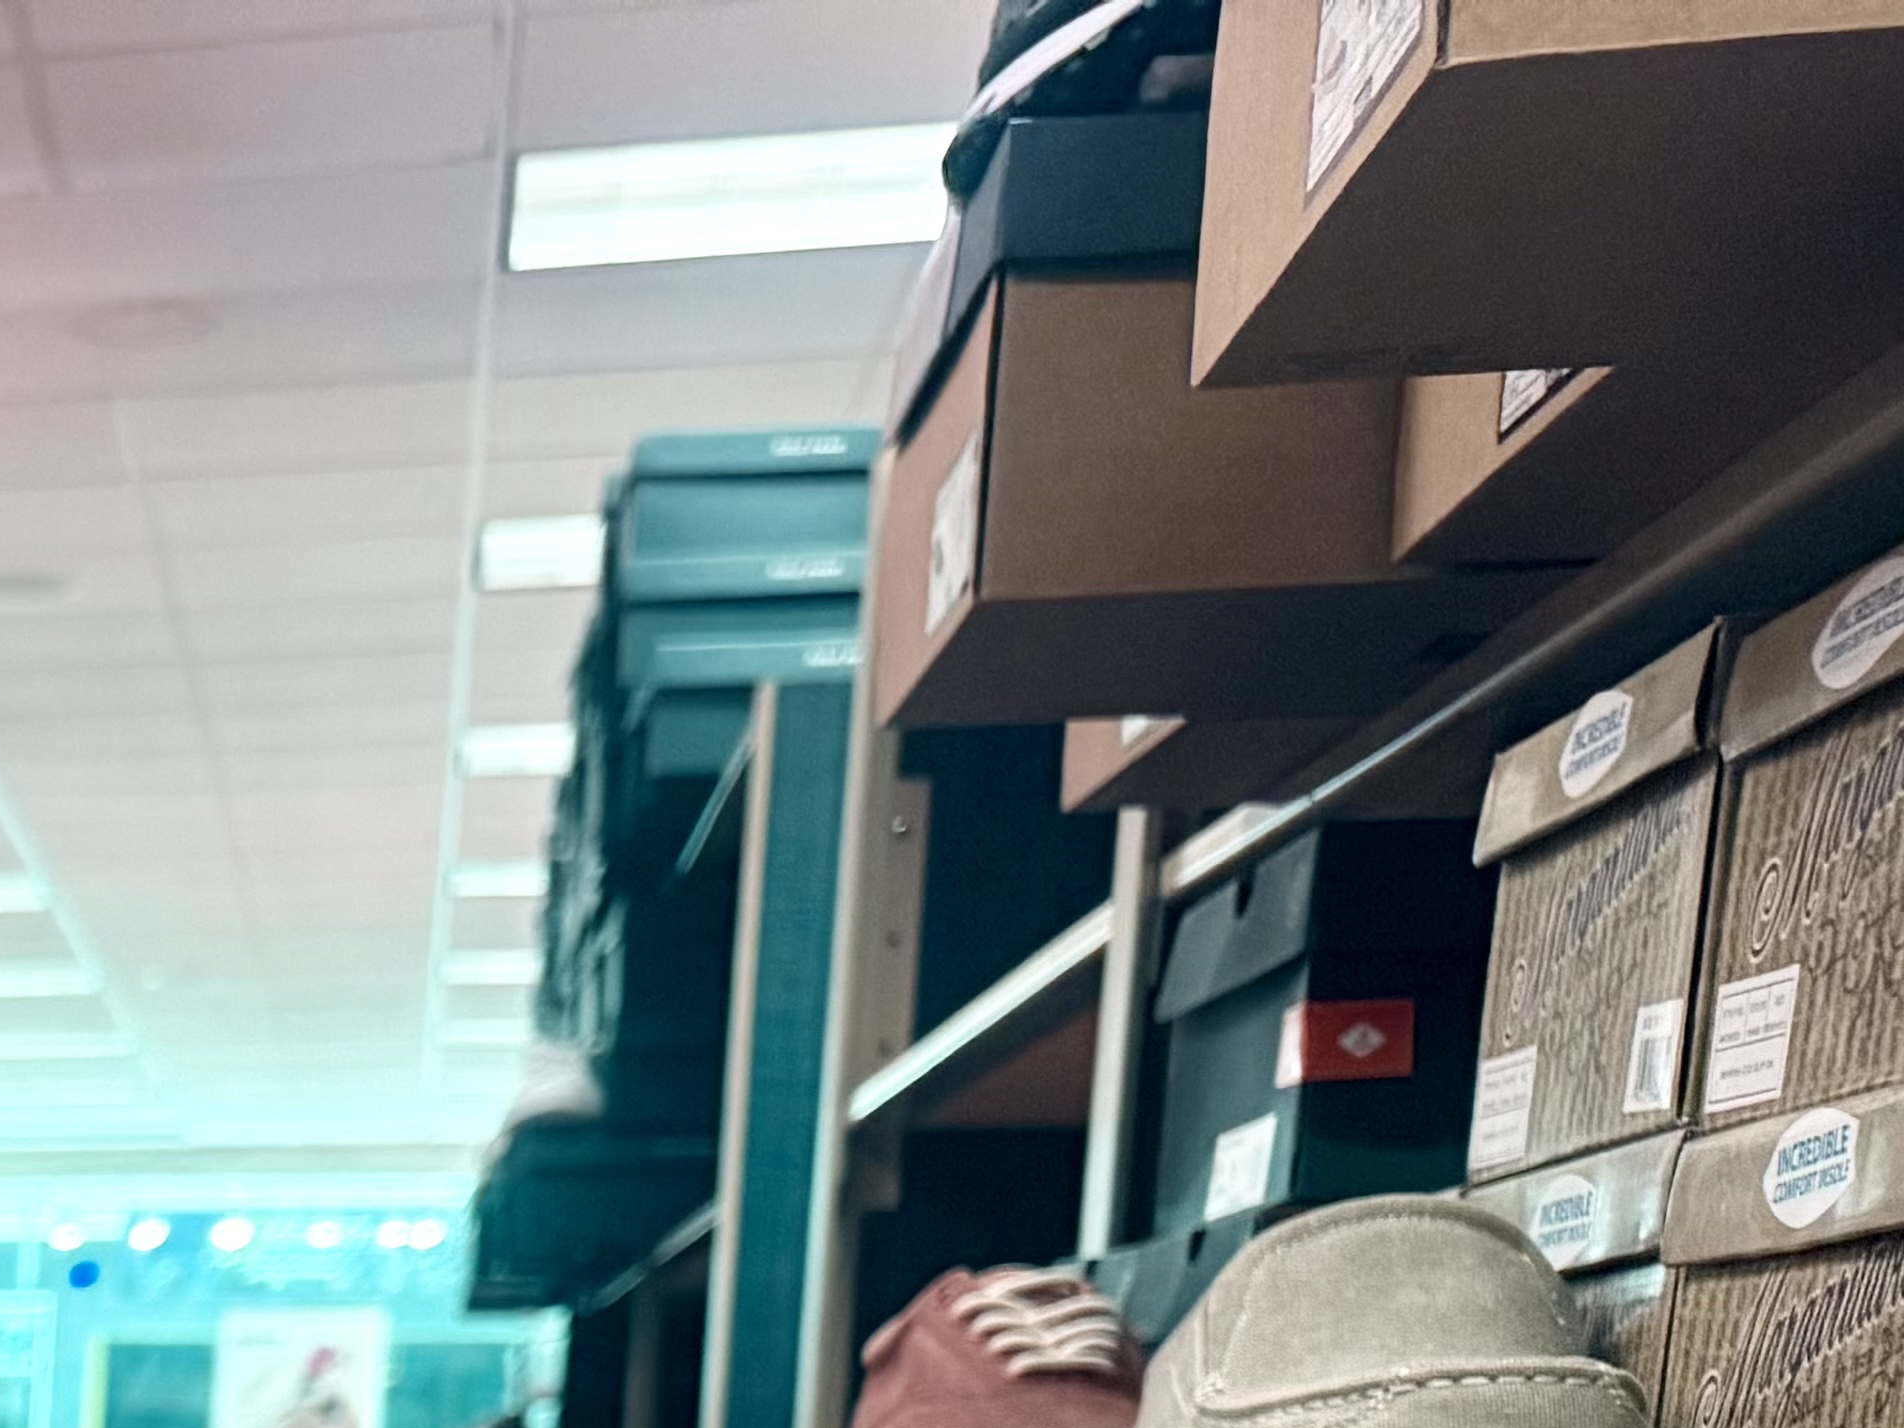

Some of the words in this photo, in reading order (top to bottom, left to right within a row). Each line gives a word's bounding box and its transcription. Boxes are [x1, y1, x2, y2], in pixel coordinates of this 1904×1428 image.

[1776, 1124, 1851, 1176] INCREDIBLE
[1773, 1172, 1818, 1205] COMFORT
[1817, 1159, 1851, 1191] INSOLE
